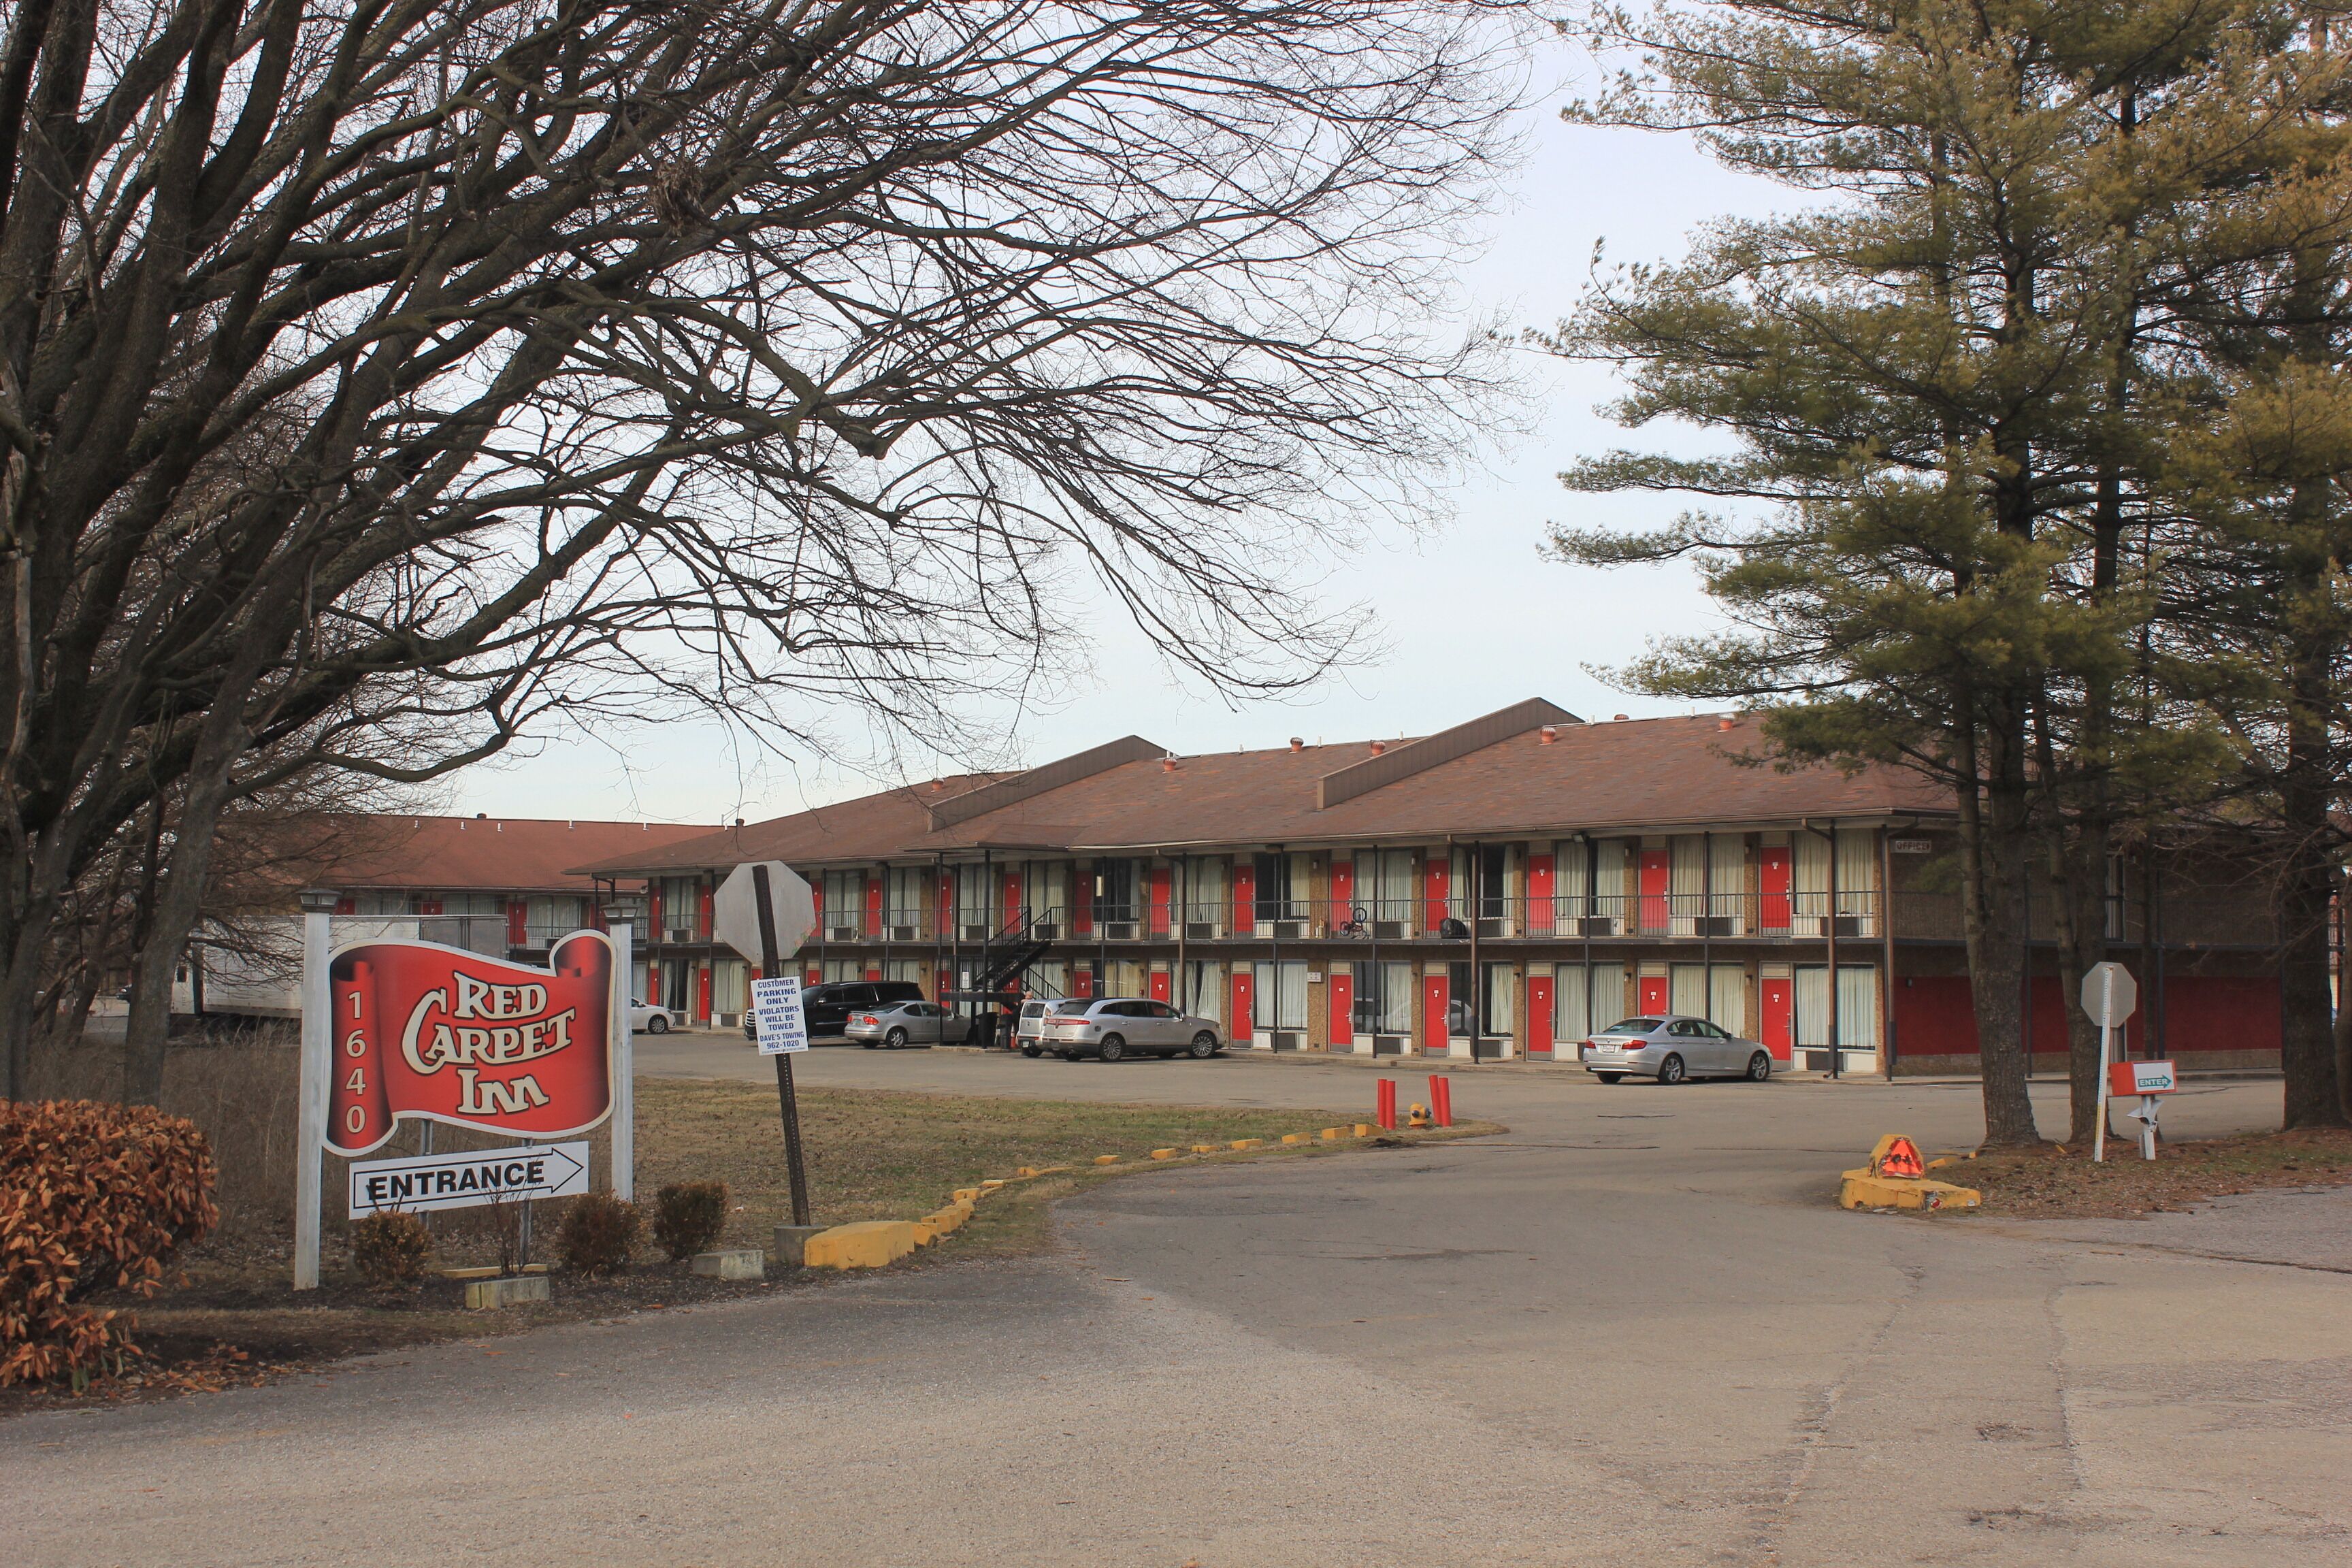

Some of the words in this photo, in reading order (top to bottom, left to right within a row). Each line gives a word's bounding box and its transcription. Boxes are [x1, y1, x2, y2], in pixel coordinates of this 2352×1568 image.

[757, 979, 794, 989] CUSTOMER
[454, 971, 547, 1019] RED
[757, 987, 796, 998] PARKING
[766, 996, 789, 1005] ONLY
[758, 1005, 800, 1015] VIOLATORS
[402, 988, 576, 1075] CARPET
[768, 1022, 794, 1031] TOWED
[760, 1033, 781, 1042] DAVE'S
[782, 1031, 804, 1040] TOWING
[766, 1039, 800, 1049] 962-1020
[368, 1160, 544, 1200] ENTRANCE
